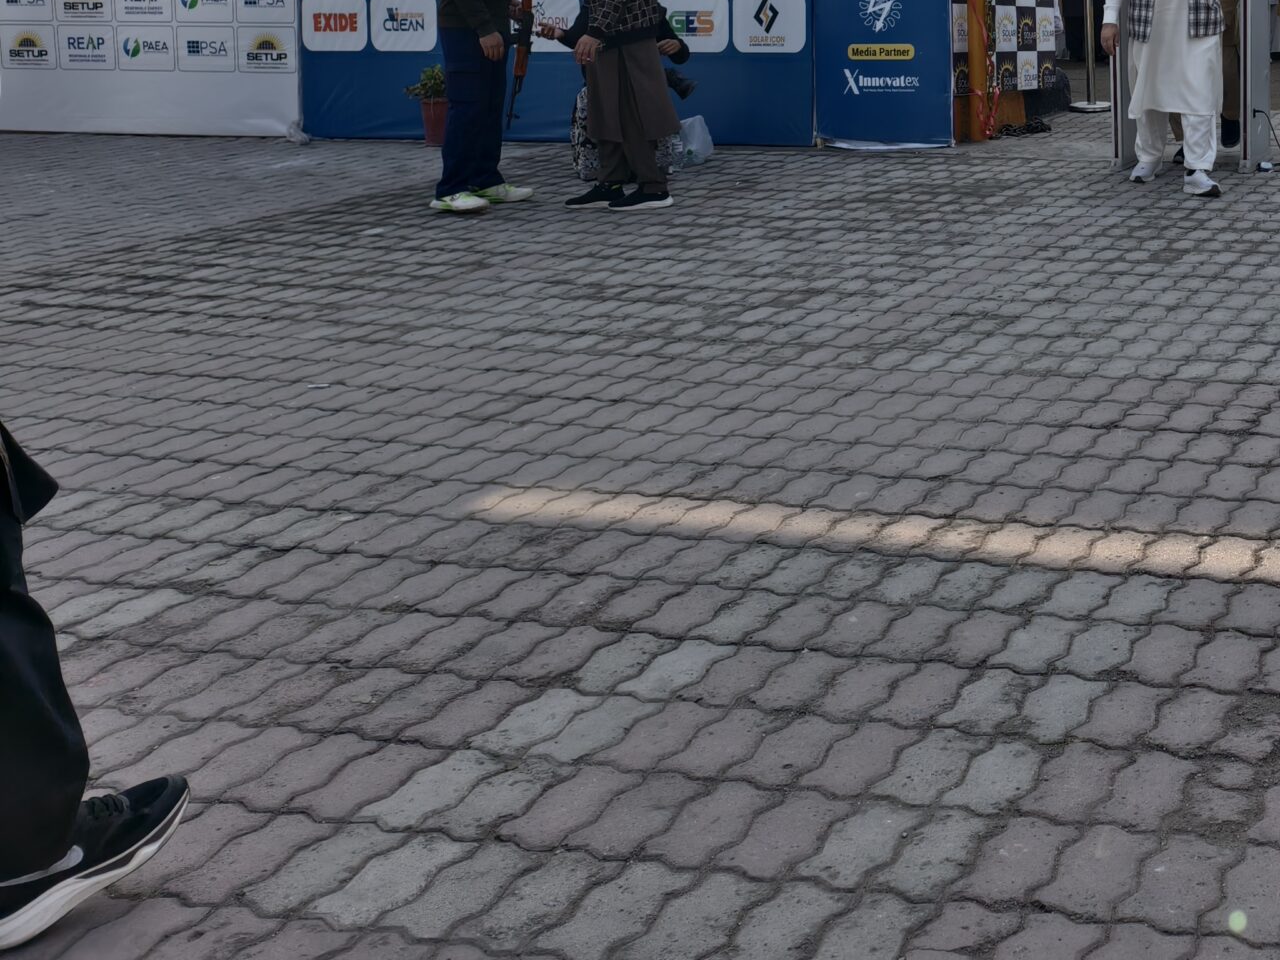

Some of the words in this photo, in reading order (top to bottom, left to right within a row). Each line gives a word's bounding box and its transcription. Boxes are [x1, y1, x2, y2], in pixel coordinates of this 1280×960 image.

[313, 13, 357, 32] EXIDE
[142, 42, 169, 52] PAEA
[200, 41, 228, 55] PSA
[852, 47, 875, 57] Media
[879, 47, 910, 57] Partner
[9, 49, 48, 59] SETUP
